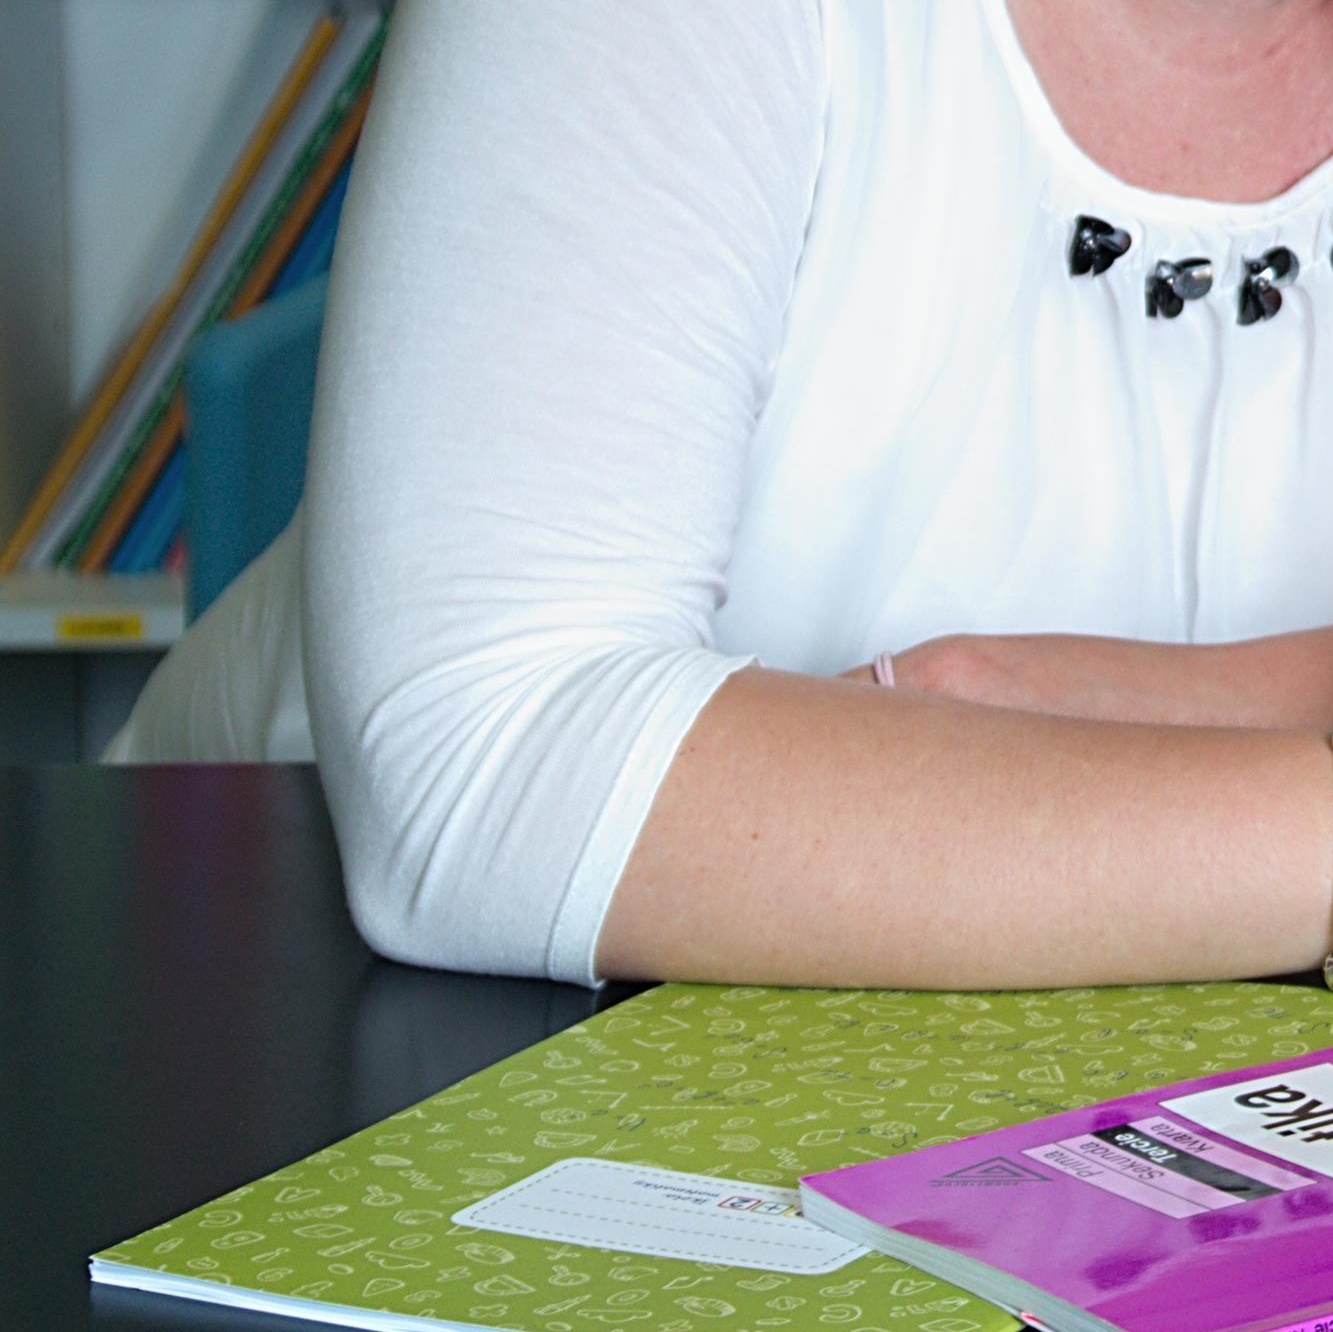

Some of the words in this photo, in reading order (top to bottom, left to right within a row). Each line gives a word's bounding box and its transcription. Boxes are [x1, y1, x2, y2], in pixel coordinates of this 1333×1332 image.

[1114, 1131, 1178, 1164] Tercie
[1150, 1122, 1215, 1154] Kvarta
[1044, 1148, 1104, 1179] Prima
[1079, 1140, 1165, 1181] Sekunda
